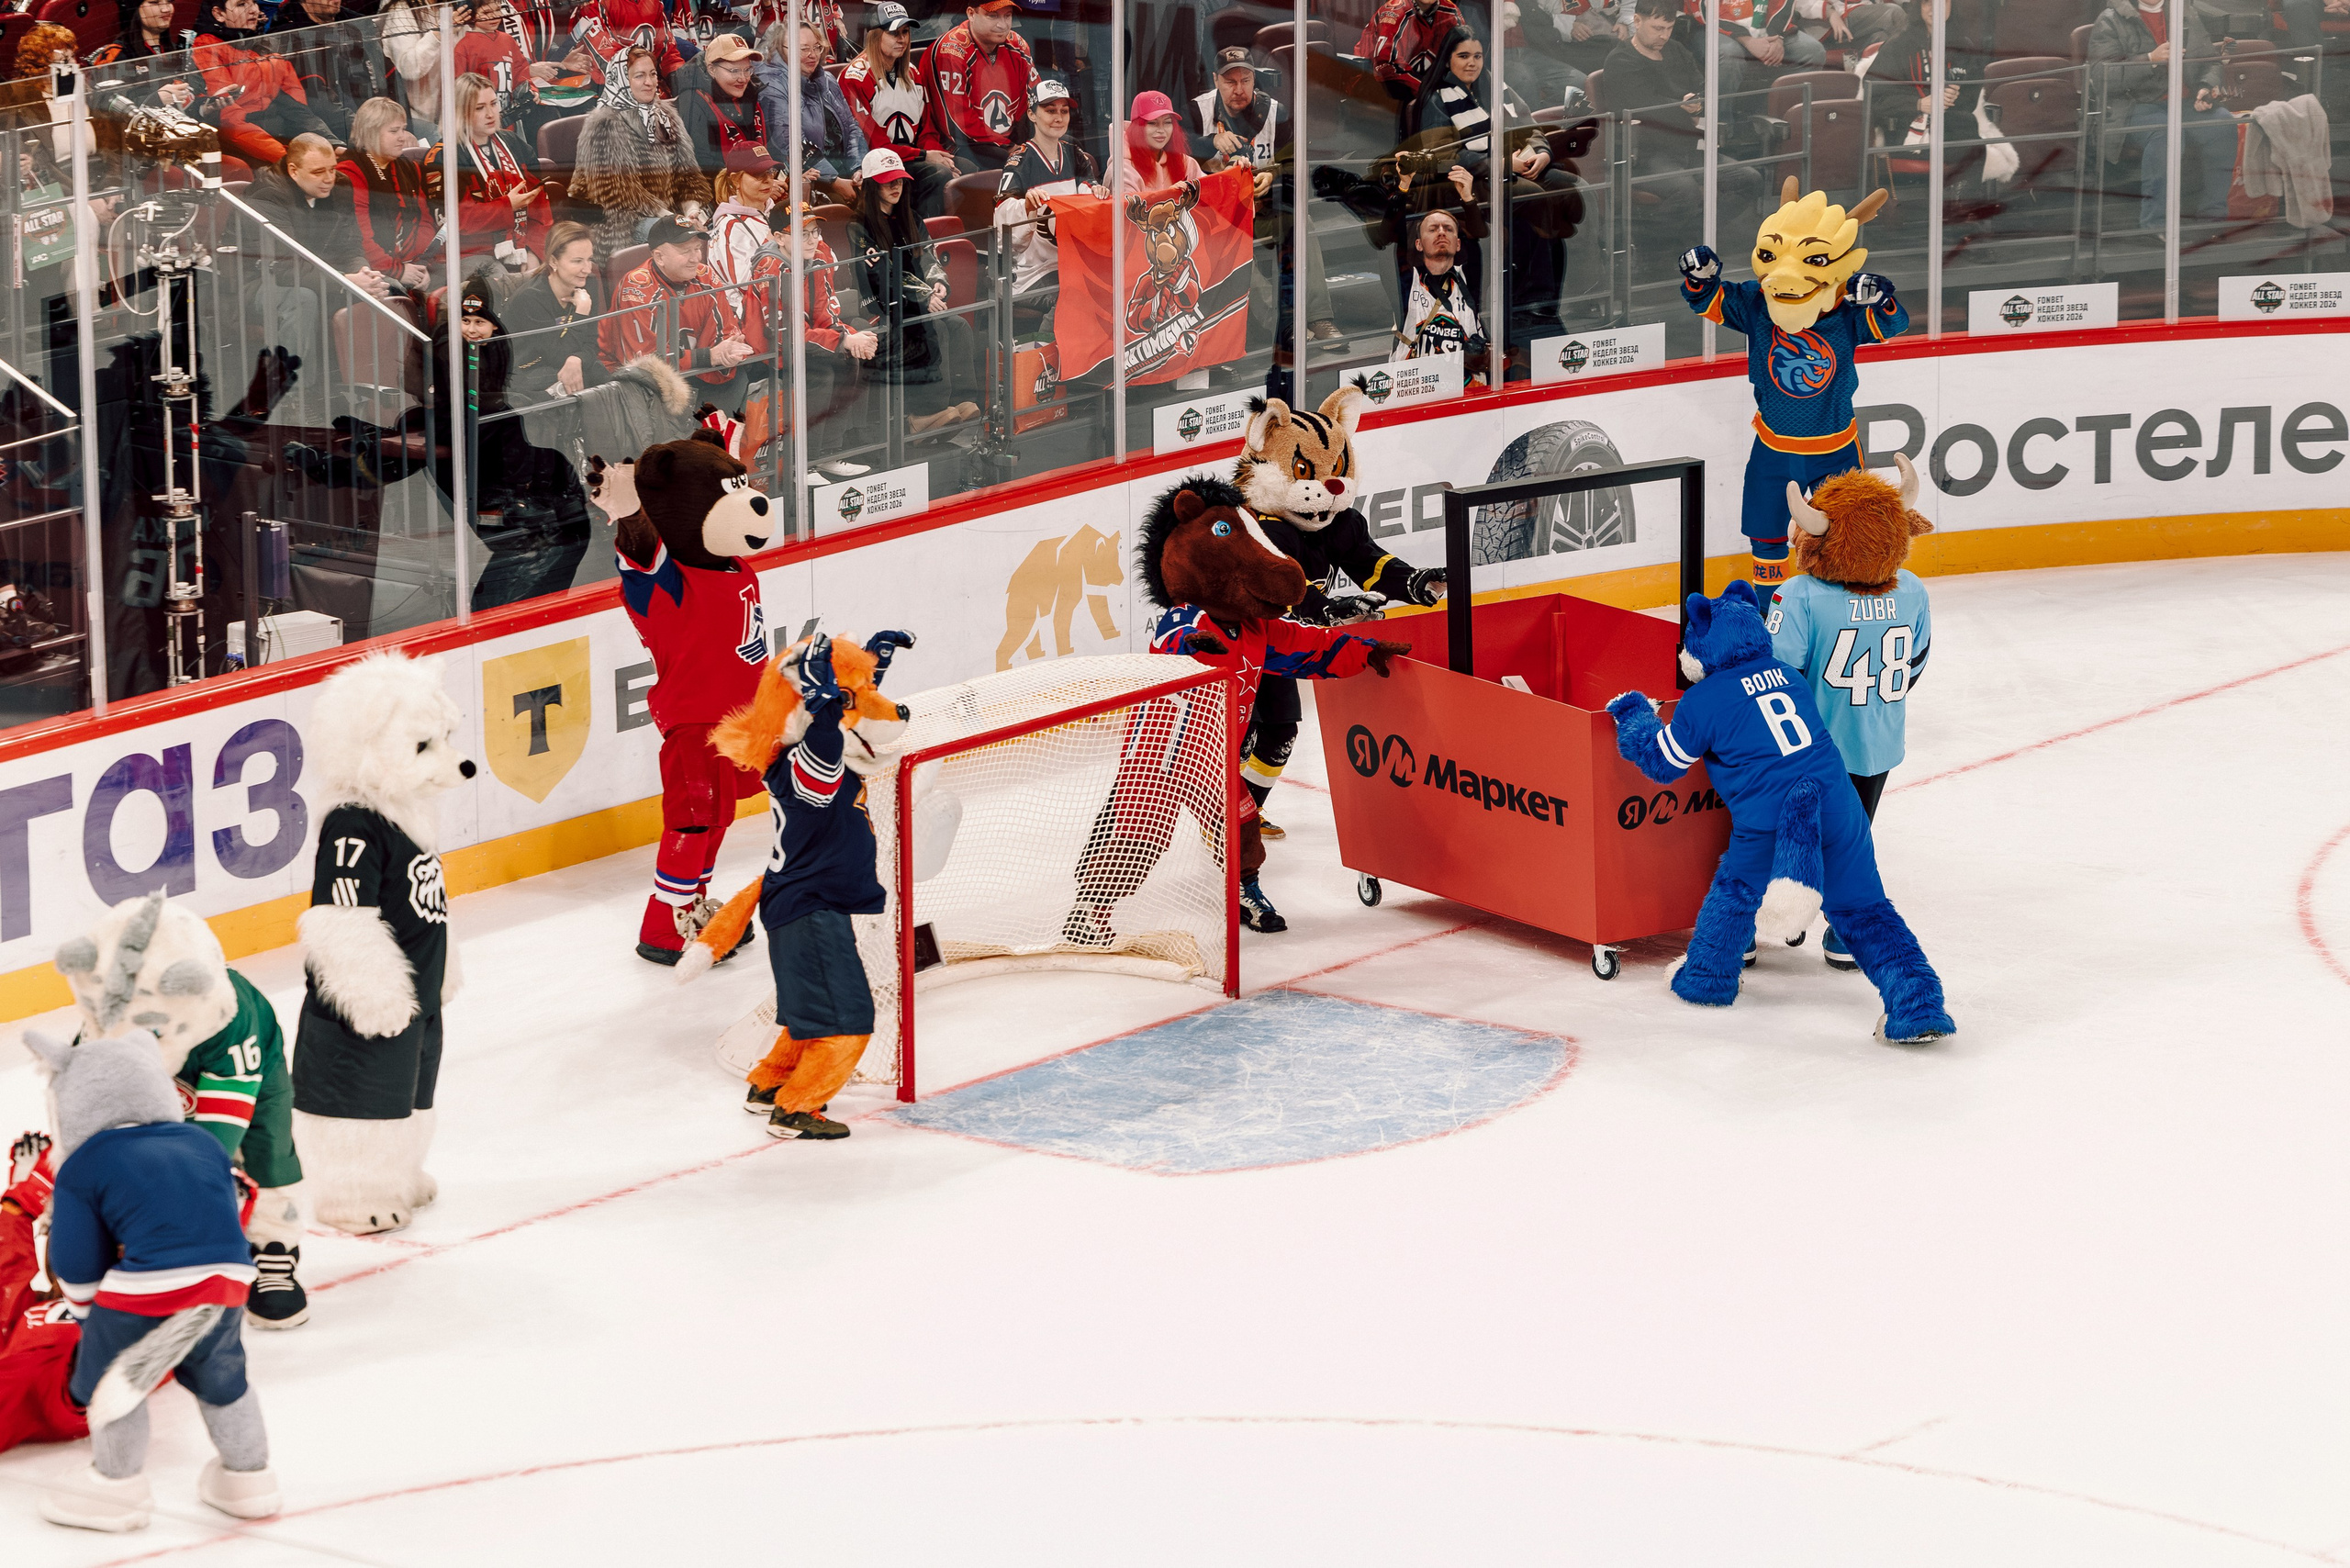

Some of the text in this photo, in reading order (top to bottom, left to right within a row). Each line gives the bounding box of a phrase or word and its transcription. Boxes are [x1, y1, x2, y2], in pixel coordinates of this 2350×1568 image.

[24, 211, 65, 233] ALL STAR
[2037, 296, 2064, 304] FONBET
[2252, 290, 2285, 301] ALL STAR
[2289, 291, 2343, 300] НЕДЕЛЯ ЗВЕЗД
[2001, 304, 2033, 314] ALL STAR
[2037, 303, 2088, 314] НЕДЕЛЯ ЗВЕЗД
[2289, 300, 2337, 309] ХОККЕЯ 2026
[2037, 313, 2083, 323] ХОККЕЯ 2026
[1593, 339, 1617, 348] FONBET
[1560, 349, 1589, 362] ALL STAR
[1593, 345, 1639, 358] НЕДЕЛЯ ЗВЕЗД
[1593, 355, 1634, 367] ХОККЕЯ 2026
[1397, 368, 1419, 378] FONBET
[1366, 379, 1393, 392] ALL STAR
[1397, 374, 1439, 388] НЕДЕЛЯ ЗВЕЗД
[1397, 385, 1436, 398] ХОККЕЯ 2026
[1205, 404, 1225, 415] FONBET
[1178, 416, 1203, 430] ALL STAR
[1205, 409, 1245, 425] НЕДЕЛЯ ЗВЕЗД
[1205, 420, 1241, 435] ХОККЕЯ 2026
[867, 482, 887, 495] FONBET
[867, 487, 906, 504] НЕДЕЛЯ ЗВЕЗД
[839, 495, 864, 510] ALL STAR
[867, 499, 902, 514] ХОККЕЯ 2026
[1849, 597, 1897, 622] ZUBR
[1822, 624, 1913, 706] 48
[1740, 668, 1789, 696] ВОЛК
[1423, 753, 1569, 827] Маркет
[334, 836, 366, 868] 17
[227, 1035, 262, 1076] 16
